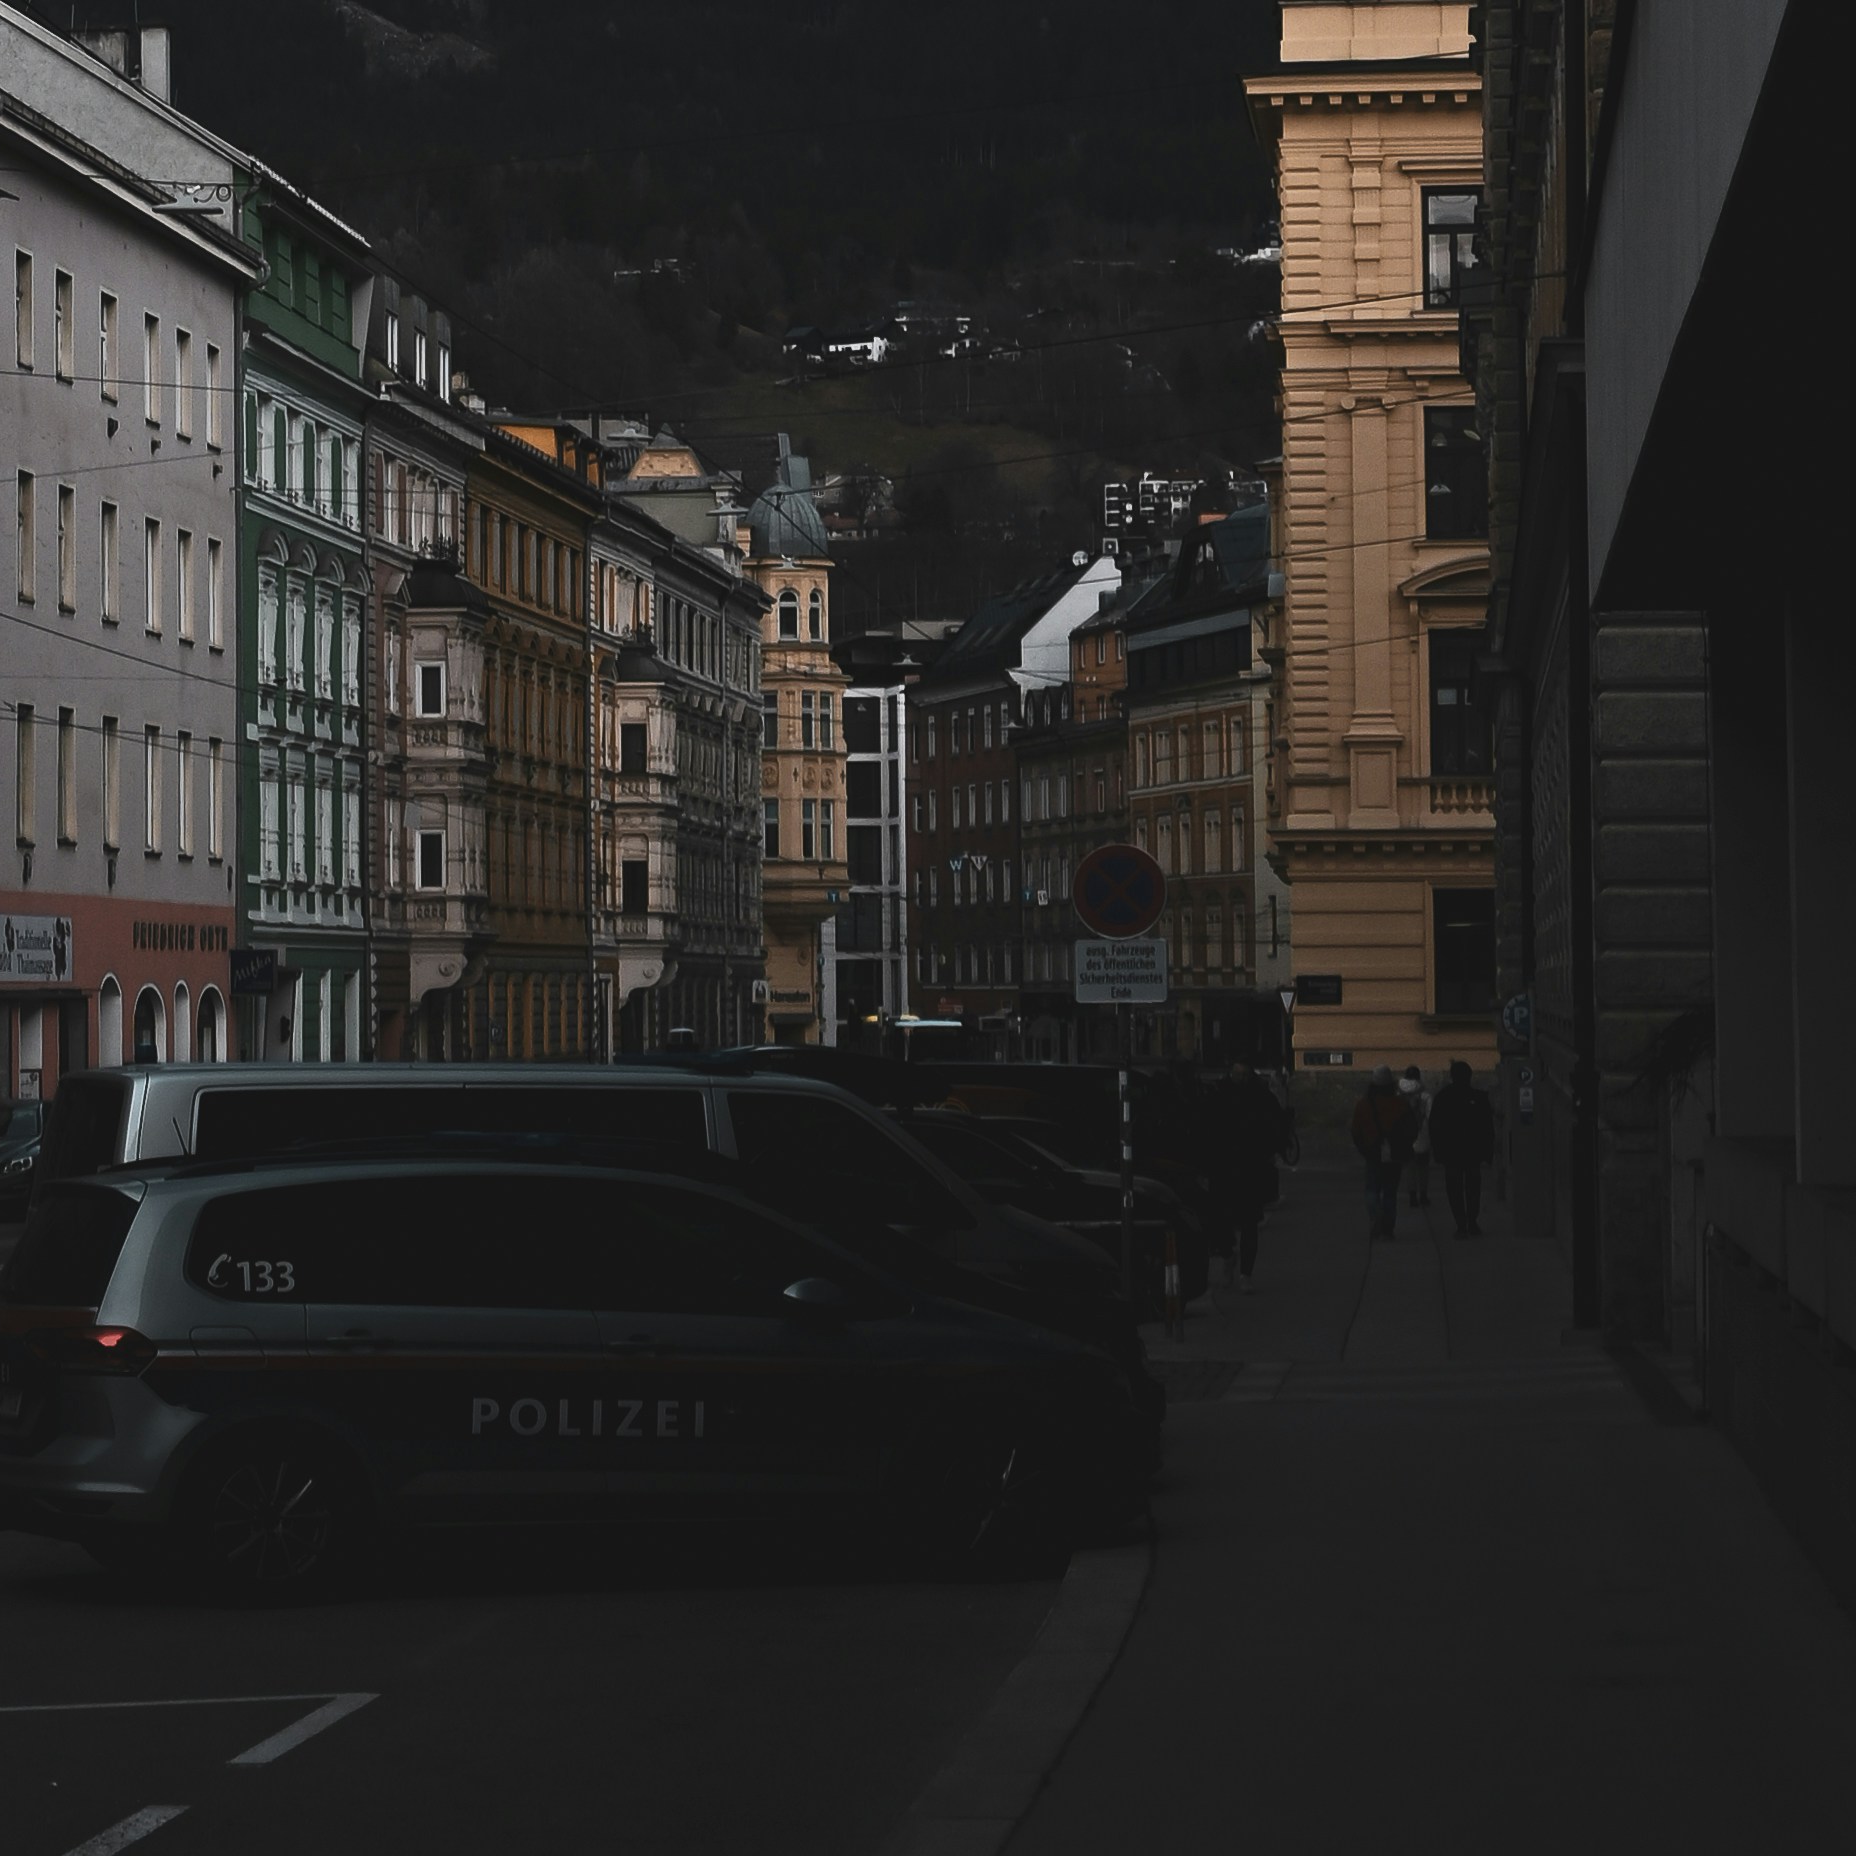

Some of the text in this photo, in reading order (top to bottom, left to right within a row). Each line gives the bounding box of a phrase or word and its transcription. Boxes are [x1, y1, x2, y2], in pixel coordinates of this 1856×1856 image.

[1086, 945, 1156, 959] ausg. Fahrzeuge
[1086, 958, 1156, 970] des öffentlichen
[1079, 972, 1163, 985] Sicherheitsdienstes
[1110, 986, 1132, 999] Ende
[1514, 1007, 1529, 1024] P
[236, 1260, 296, 1293] 133
[471, 1397, 705, 1438] POLIZEI
